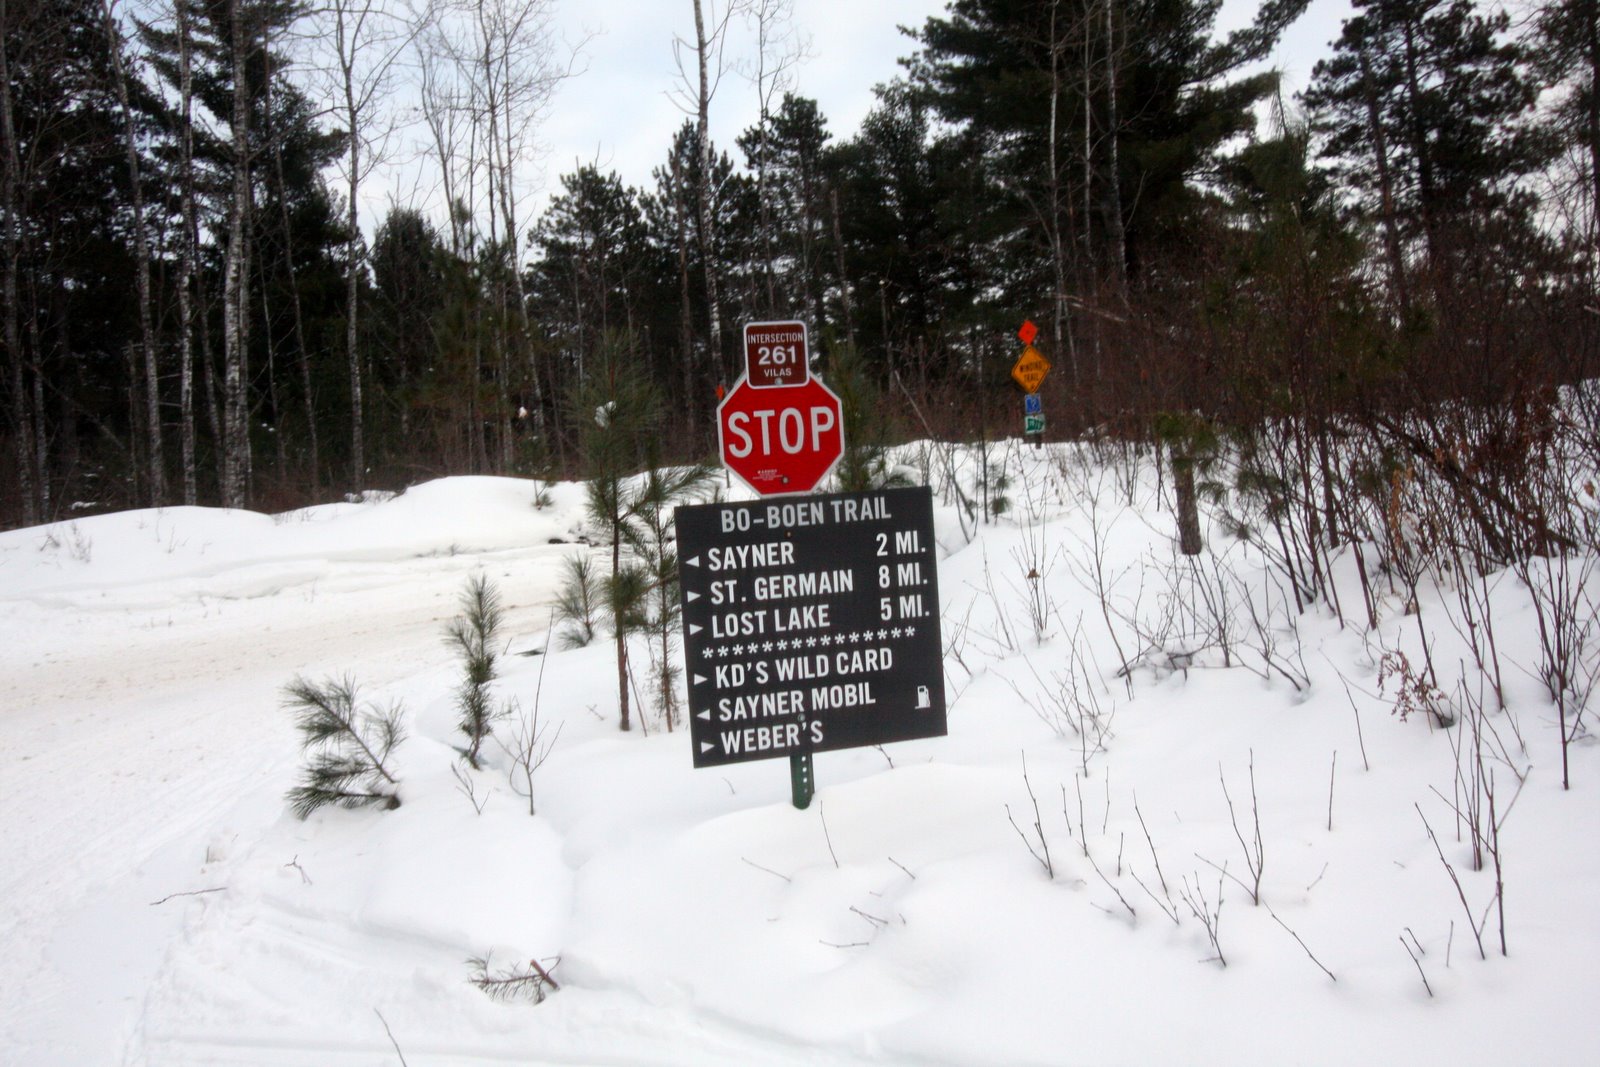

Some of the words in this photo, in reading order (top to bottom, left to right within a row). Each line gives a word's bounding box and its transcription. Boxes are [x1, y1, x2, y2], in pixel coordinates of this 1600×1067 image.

[748, 332, 804, 344] INTERSECTION
[758, 345, 796, 365] 261
[764, 368, 792, 377] VILAS
[728, 406, 834, 458] STOP
[721, 501, 824, 533] BO-BOEN
[831, 497, 892, 523] TRAIL
[708, 541, 795, 571] SAYNER
[875, 533, 888, 556] 2
[895, 530, 926, 555] MI.
[710, 580, 747, 605] ST.
[754, 569, 853, 600] GERMAIN
[878, 565, 890, 588] 8
[897, 562, 928, 587] MI.
[712, 610, 767, 638] LOST
[774, 604, 831, 632] LAKE
[880, 598, 892, 621] 5
[899, 594, 930, 619] MI.
[715, 661, 769, 689] KD'S
[775, 654, 829, 682] WILD
[836, 648, 893, 675] CARD
[718, 690, 804, 722] SAYNER
[811, 682, 876, 710] MOBIL
[721, 721, 824, 755] WEBER'S
